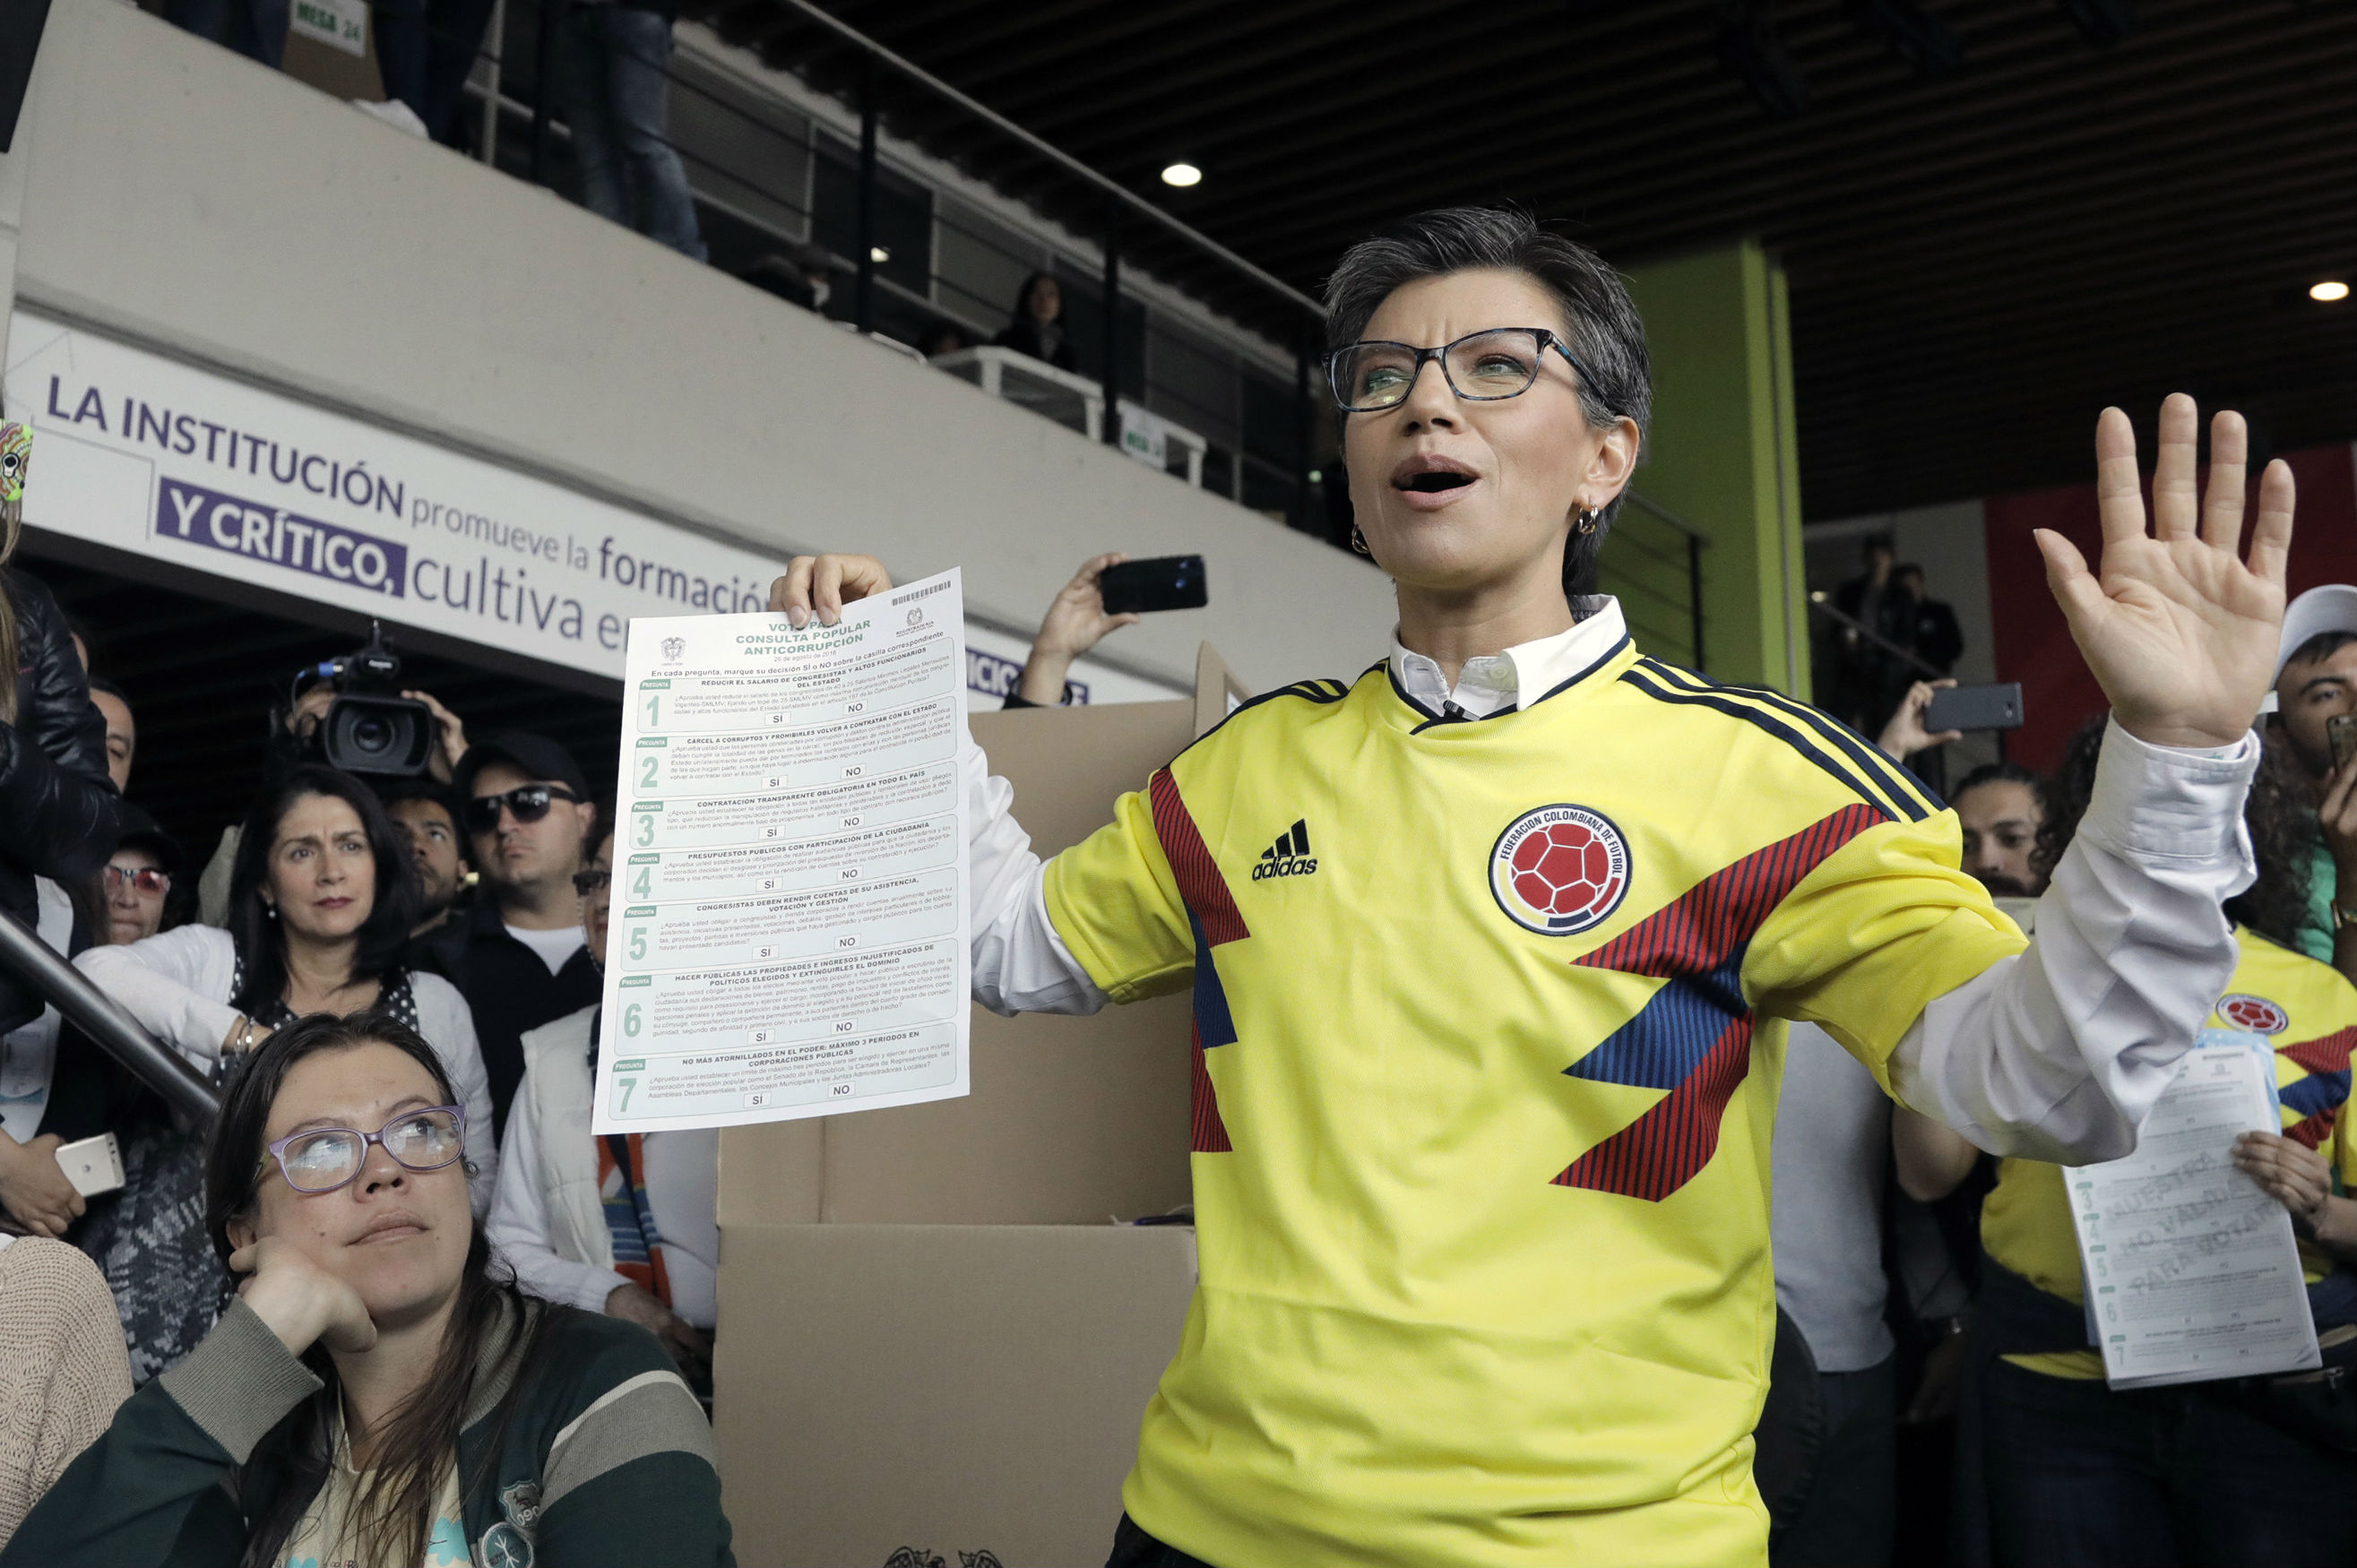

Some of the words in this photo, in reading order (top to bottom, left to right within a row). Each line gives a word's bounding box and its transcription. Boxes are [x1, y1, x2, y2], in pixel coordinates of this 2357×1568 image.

[47, 374, 109, 432] LA
[121, 396, 404, 519] INSTITUCIÓN
[410, 495, 561, 563] promueve
[565, 533, 590, 571] la
[599, 538, 770, 613] formació
[168, 488, 203, 538] Y
[209, 500, 398, 595] CRÍTICO,
[412, 555, 583, 642] cultiva
[736, 633, 808, 643] CONSULTA
[812, 619, 870, 640] POPULAR
[769, 623, 804, 632] VOT
[744, 633, 863, 655] ANTICORRUPCIÓN
[767, 665, 800, 674] decisión
[802, 663, 810, 672] SÍ
[819, 660, 832, 668] NO
[833, 657, 853, 667] sobre
[862, 647, 885, 659] casilla
[887, 631, 944, 652] correspondiente
[791, 668, 847, 682] CONGRESISTAS
[853, 660, 876, 672] ALTOS
[876, 645, 926, 667] FUNCIONARIOS
[797, 680, 811, 688] DEL
[812, 676, 841, 686] ESTADO
[646, 695, 660, 727] 1
[721, 735, 763, 743] CORRUPTOS
[771, 729, 815, 739] PROHIBIRLES
[816, 725, 842, 735] VOLVER
[849, 715, 887, 728] CONTRATAR
[888, 711, 902, 720] CON
[902, 709, 911, 717] EL
[912, 702, 937, 714] ESTADO
[848, 701, 864, 714] NO
[640, 755, 659, 788] 2
[756, 791, 815, 804] TRANSPARENTE
[816, 783, 865, 797] OBLIGATORIA
[865, 780, 876, 788] EN
[877, 776, 897, 786] TODO
[898, 773, 908, 781] EL
[909, 770, 925, 779] PAÍS
[845, 766, 861, 778] NO
[637, 814, 654, 847] 3
[843, 815, 859, 828] NO
[687, 849, 747, 860] PRESUPUESTOS
[787, 843, 804, 851] CON
[862, 832, 873, 840] DE
[885, 821, 929, 835] CIUDADANÍA
[1499, 815, 1542, 860] FEDERACION
[1543, 810, 1603, 832] COLOMBIANA
[1601, 828, 1613, 843] DE
[1607, 840, 1623, 874] FUTBOL
[633, 866, 652, 900] 4
[842, 868, 859, 879] NO
[1252, 855, 1317, 881] adidas
[696, 900, 754, 911] CONGRESISTAS
[755, 897, 781, 907] DEBEN
[783, 894, 811, 903] RENDIR
[813, 888, 847, 900] CUENTAS
[849, 886, 859, 894] DE
[860, 884, 871, 892] SU
[768, 901, 807, 912] VOTACIÓN
[815, 896, 849, 907] GESTIÓN
[629, 927, 647, 961] 5
[839, 936, 856, 948] NO
[674, 973, 701, 981] HACER
[758, 961, 812, 974] PROPIEDADES
[813, 961, 819, 969] E
[819, 955, 859, 968] INGRESOS
[859, 945, 922, 961] INJUSTIFICADOS
[924, 943, 934, 951] DE
[709, 977, 750, 986] POLÍTICOS
[752, 972, 790, 982] ELEGIDOS
[799, 963, 854, 978] EXTINGUIRLES
[855, 961, 865, 969] EL
[867, 956, 900, 968] DOMINIO
[624, 1003, 642, 1038] 6
[835, 1021, 853, 1033] NO
[682, 1057, 694, 1065] NO
[695, 1055, 712, 1064] MÁS
[713, 1051, 773, 1063] ATORNILLADOS
[787, 1047, 797, 1055] EL
[868, 1032, 907, 1044] PERIODOS
[747, 1053, 814, 1067] CORPORACIONES
[618, 1077, 637, 1112] 7
[833, 1084, 850, 1096] NO
